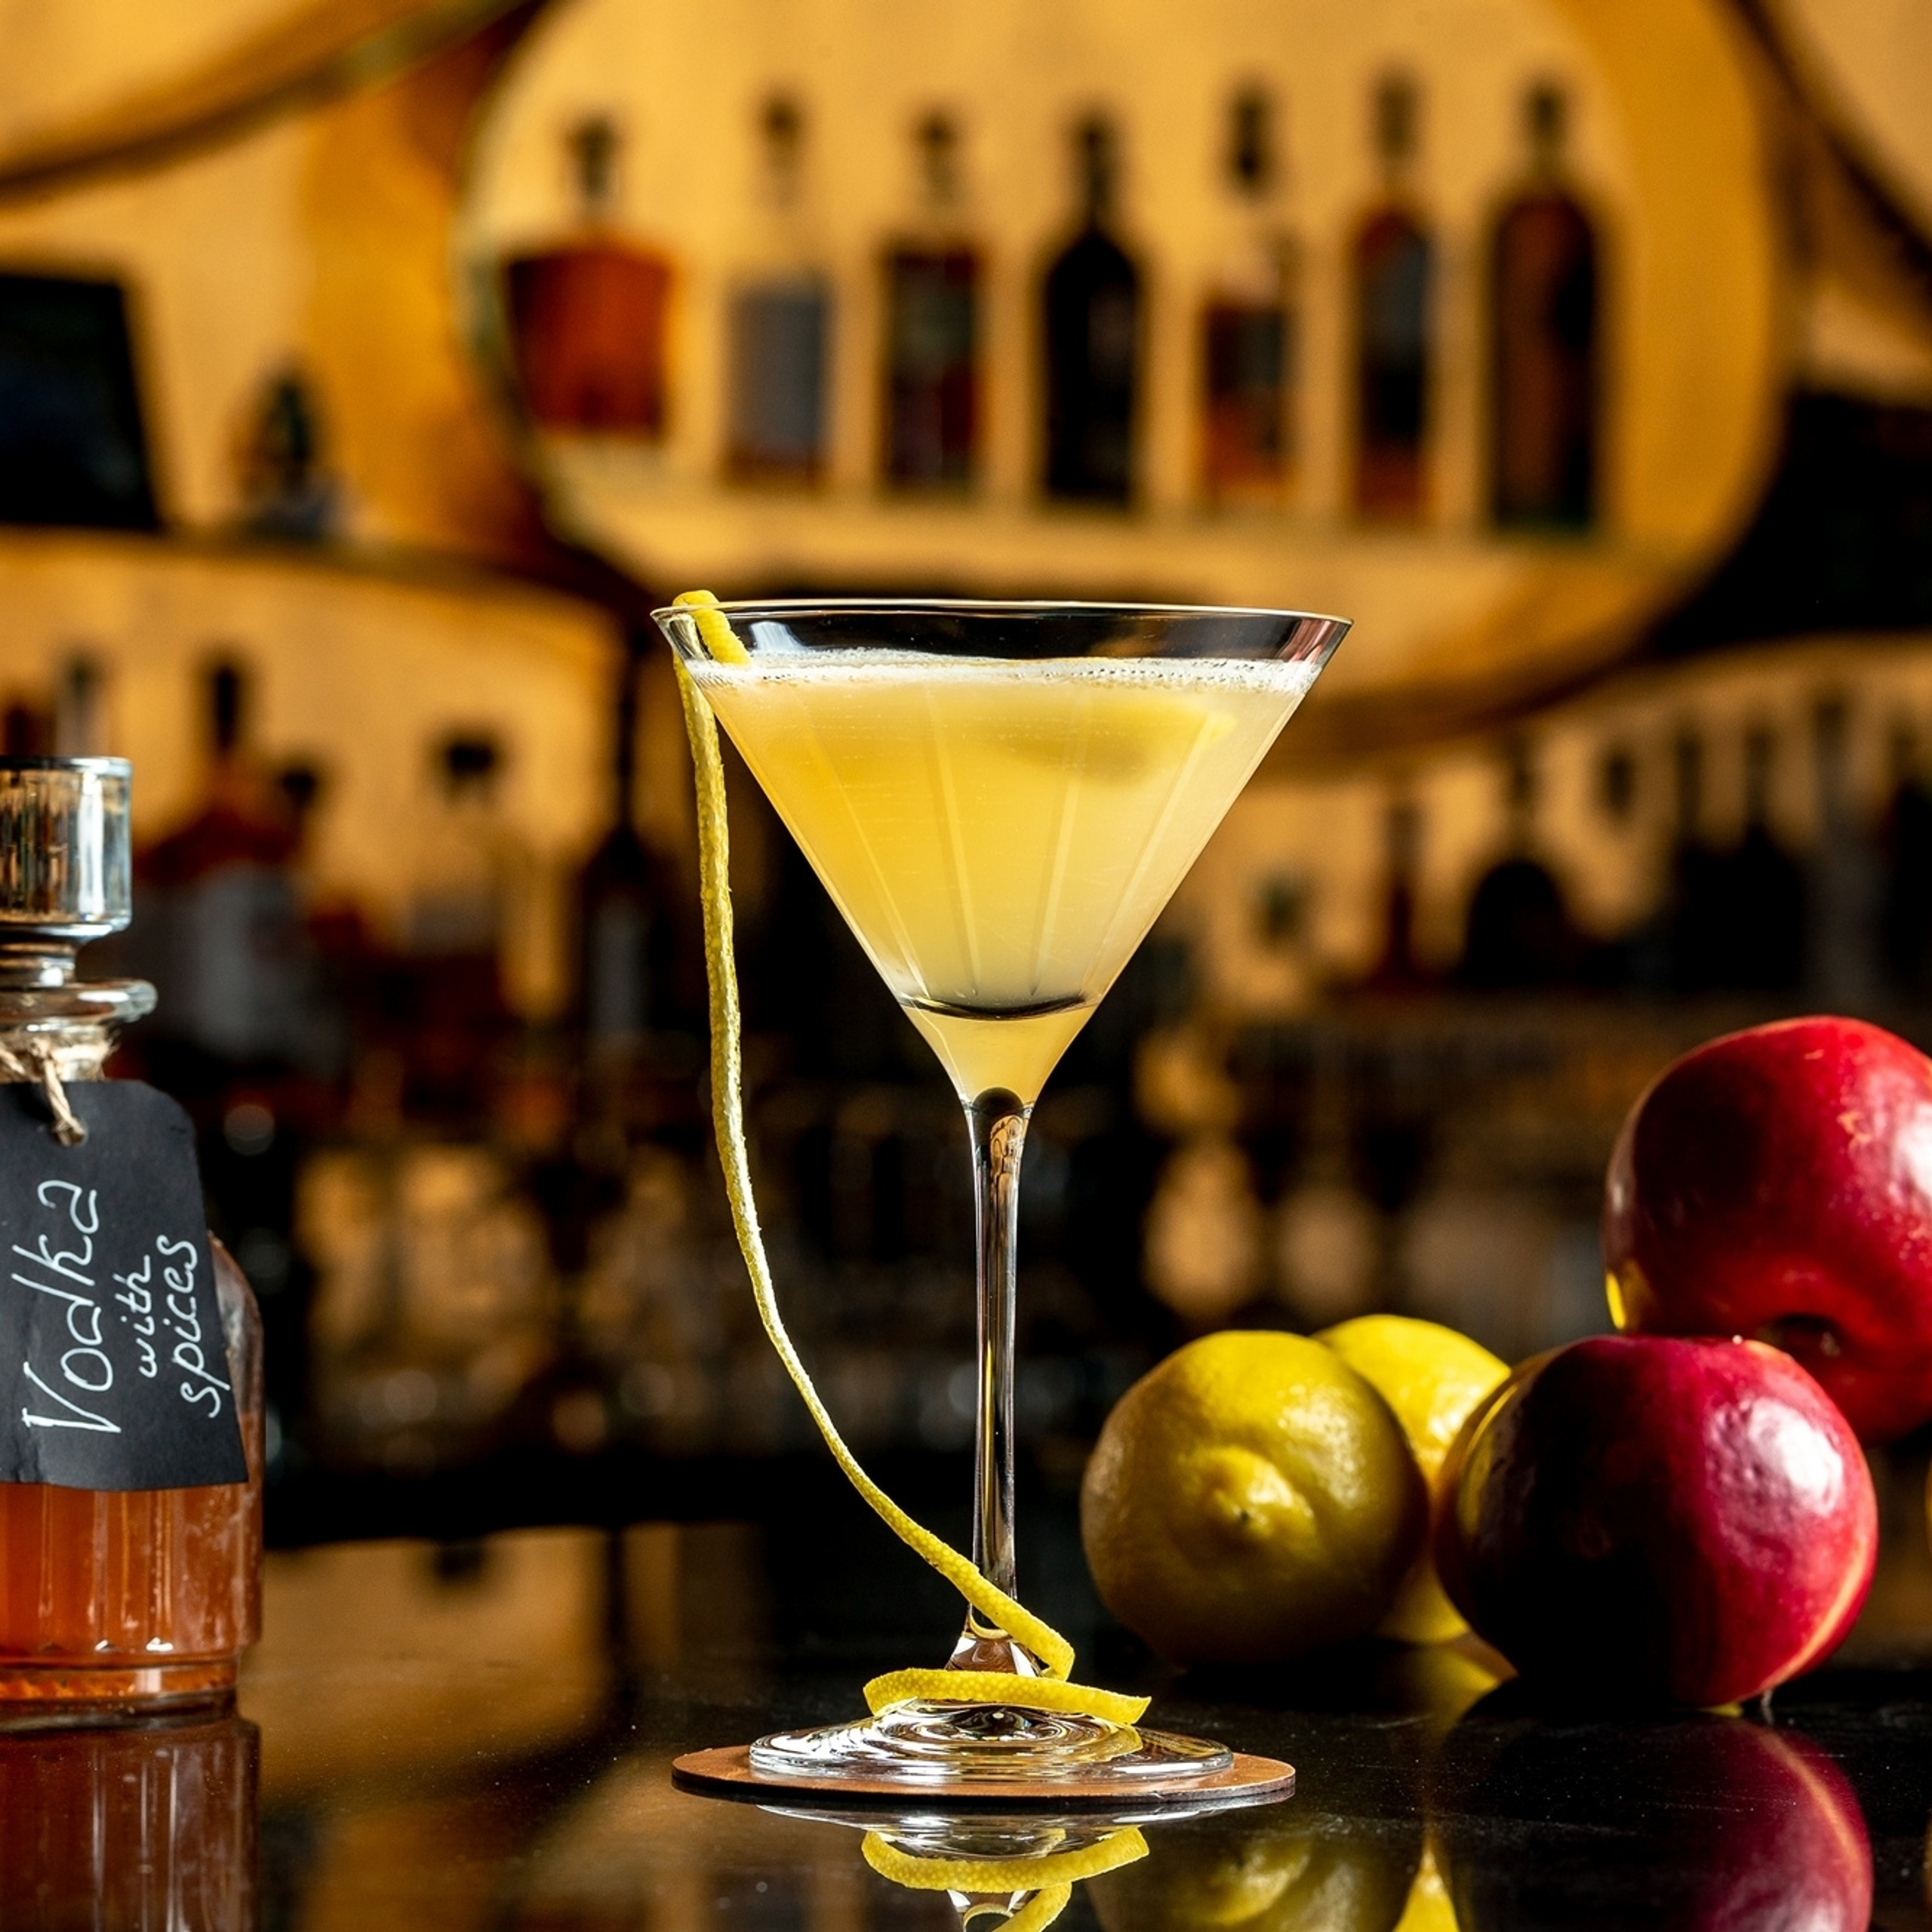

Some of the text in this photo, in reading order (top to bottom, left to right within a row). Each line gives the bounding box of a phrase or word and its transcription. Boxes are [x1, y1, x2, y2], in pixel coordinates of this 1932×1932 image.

[11, 1180, 122, 1433] Vodka
[113, 1254, 158, 1377] with
[156, 1235, 230, 1418] spices
